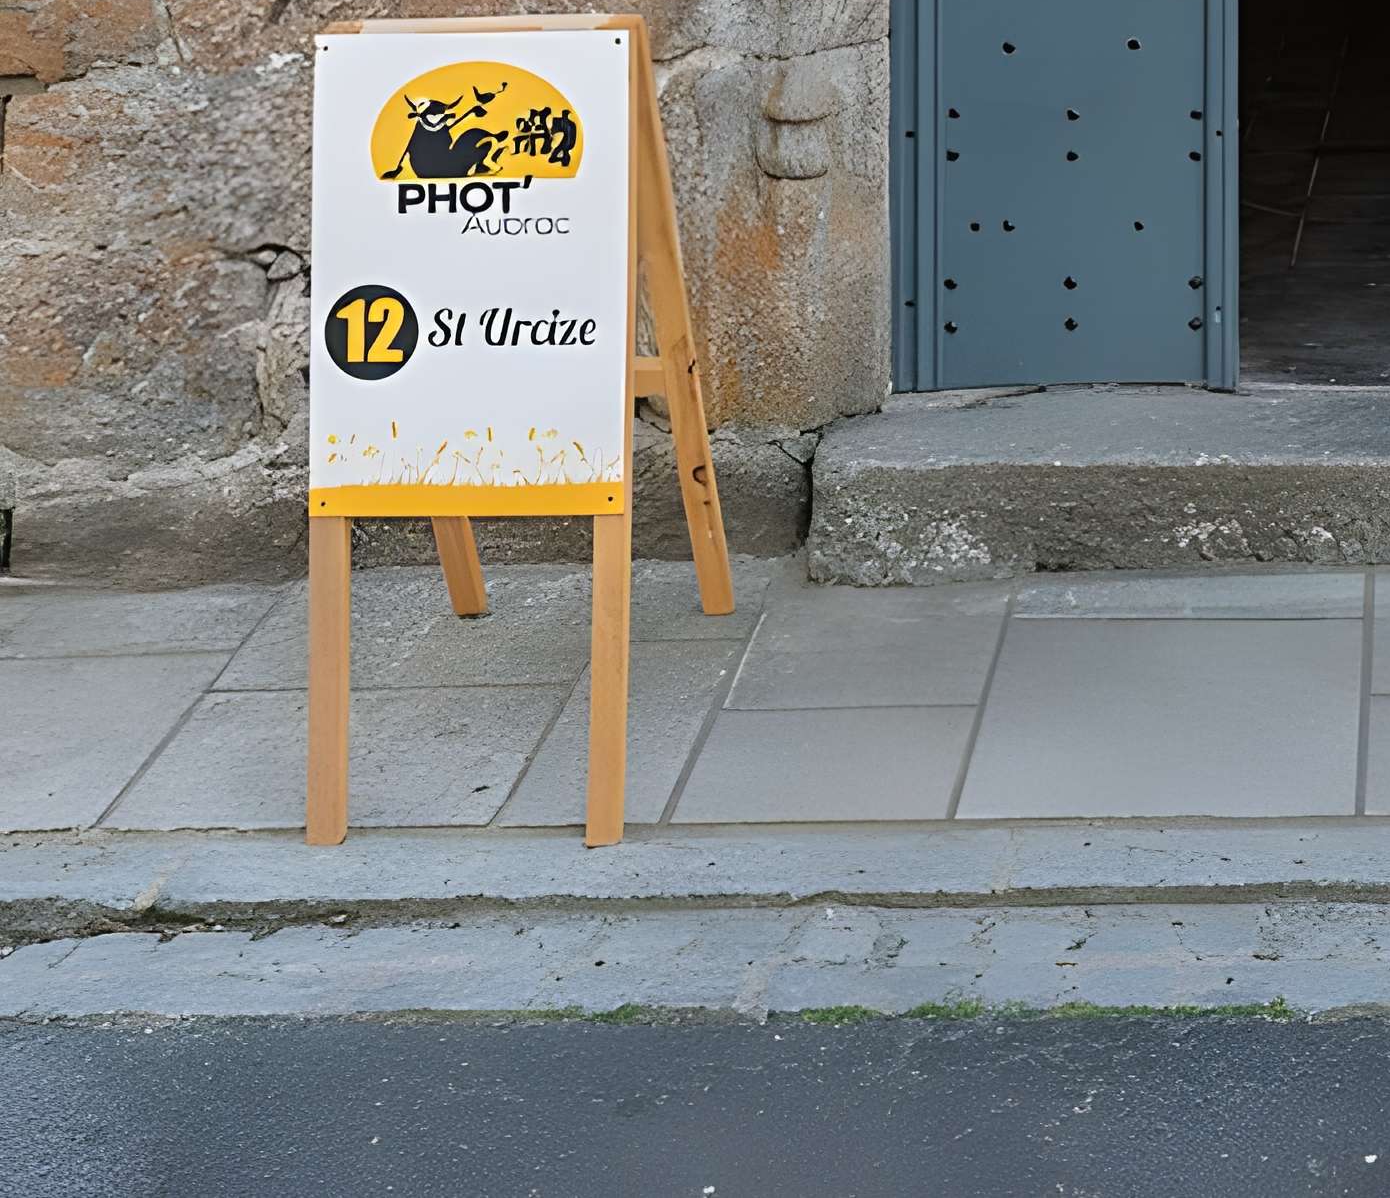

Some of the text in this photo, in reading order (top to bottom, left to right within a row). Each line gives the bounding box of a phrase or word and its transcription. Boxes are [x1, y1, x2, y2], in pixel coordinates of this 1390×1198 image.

[398, 175, 533, 214] PHOT'
[336, 297, 405, 363] 12
[480, 308, 597, 347] Urcize
